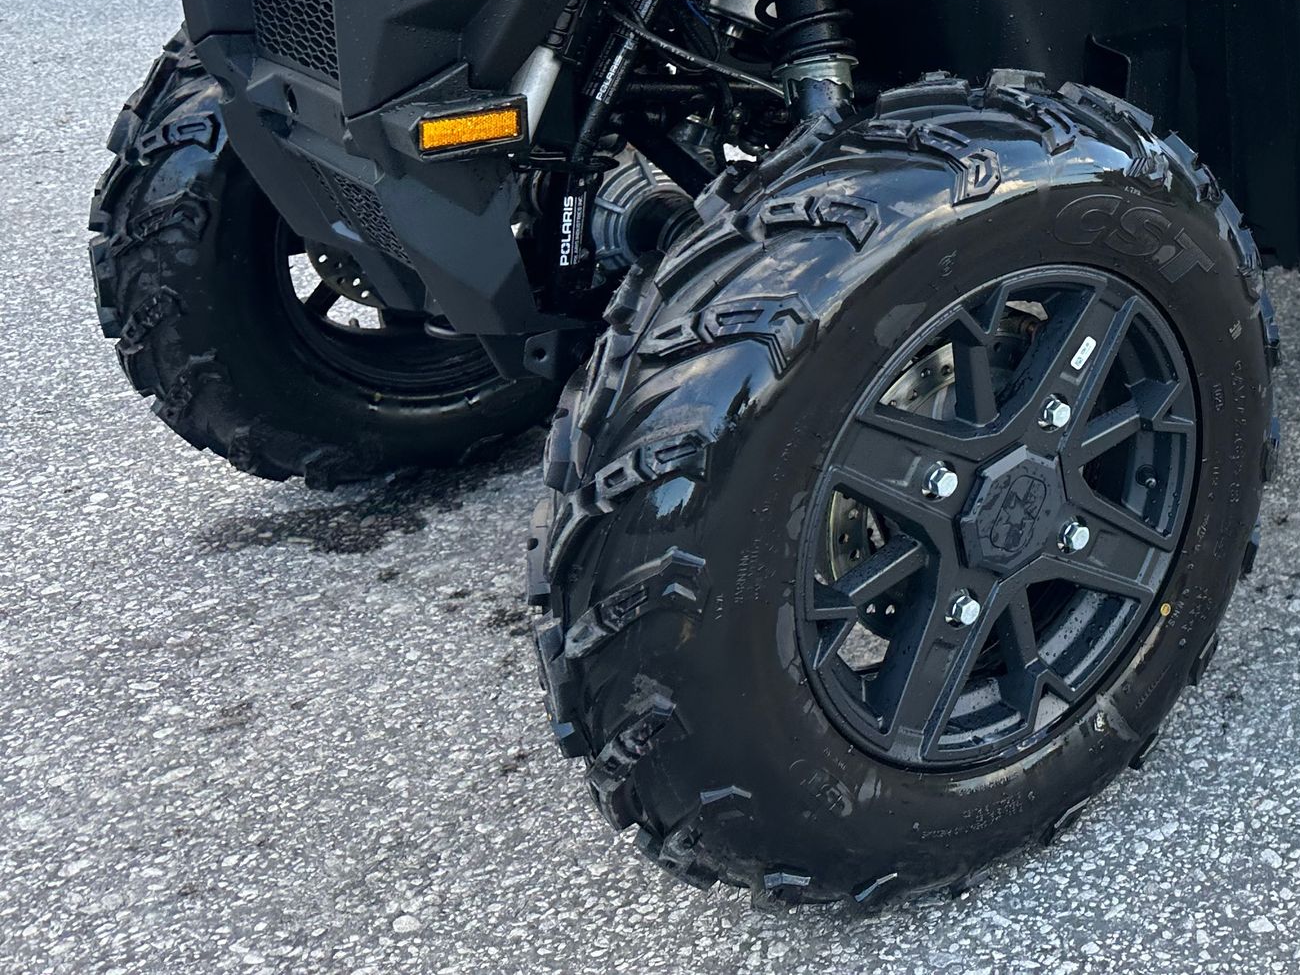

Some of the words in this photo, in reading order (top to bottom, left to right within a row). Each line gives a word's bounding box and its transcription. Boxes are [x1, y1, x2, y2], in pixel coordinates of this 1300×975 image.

[595, 55, 623, 101] POLARIS
[560, 195, 574, 266] POLARIS
[1053, 193, 1216, 284] CST
